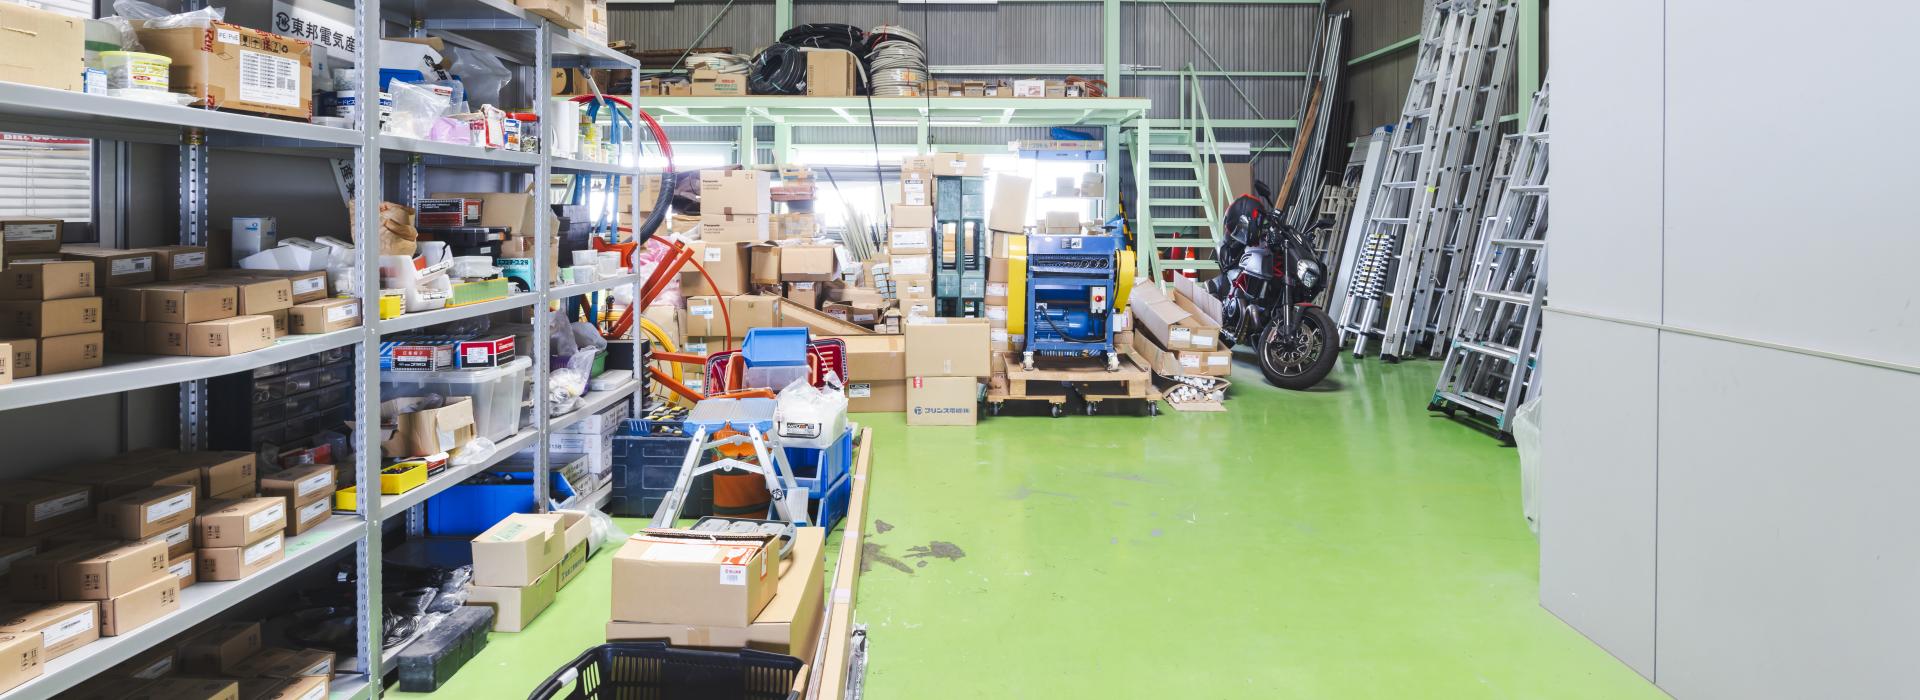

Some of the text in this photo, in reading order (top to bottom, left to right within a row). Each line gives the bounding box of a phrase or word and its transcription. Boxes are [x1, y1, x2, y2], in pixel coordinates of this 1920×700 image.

[291, 17, 355, 53] 東邦電気産
